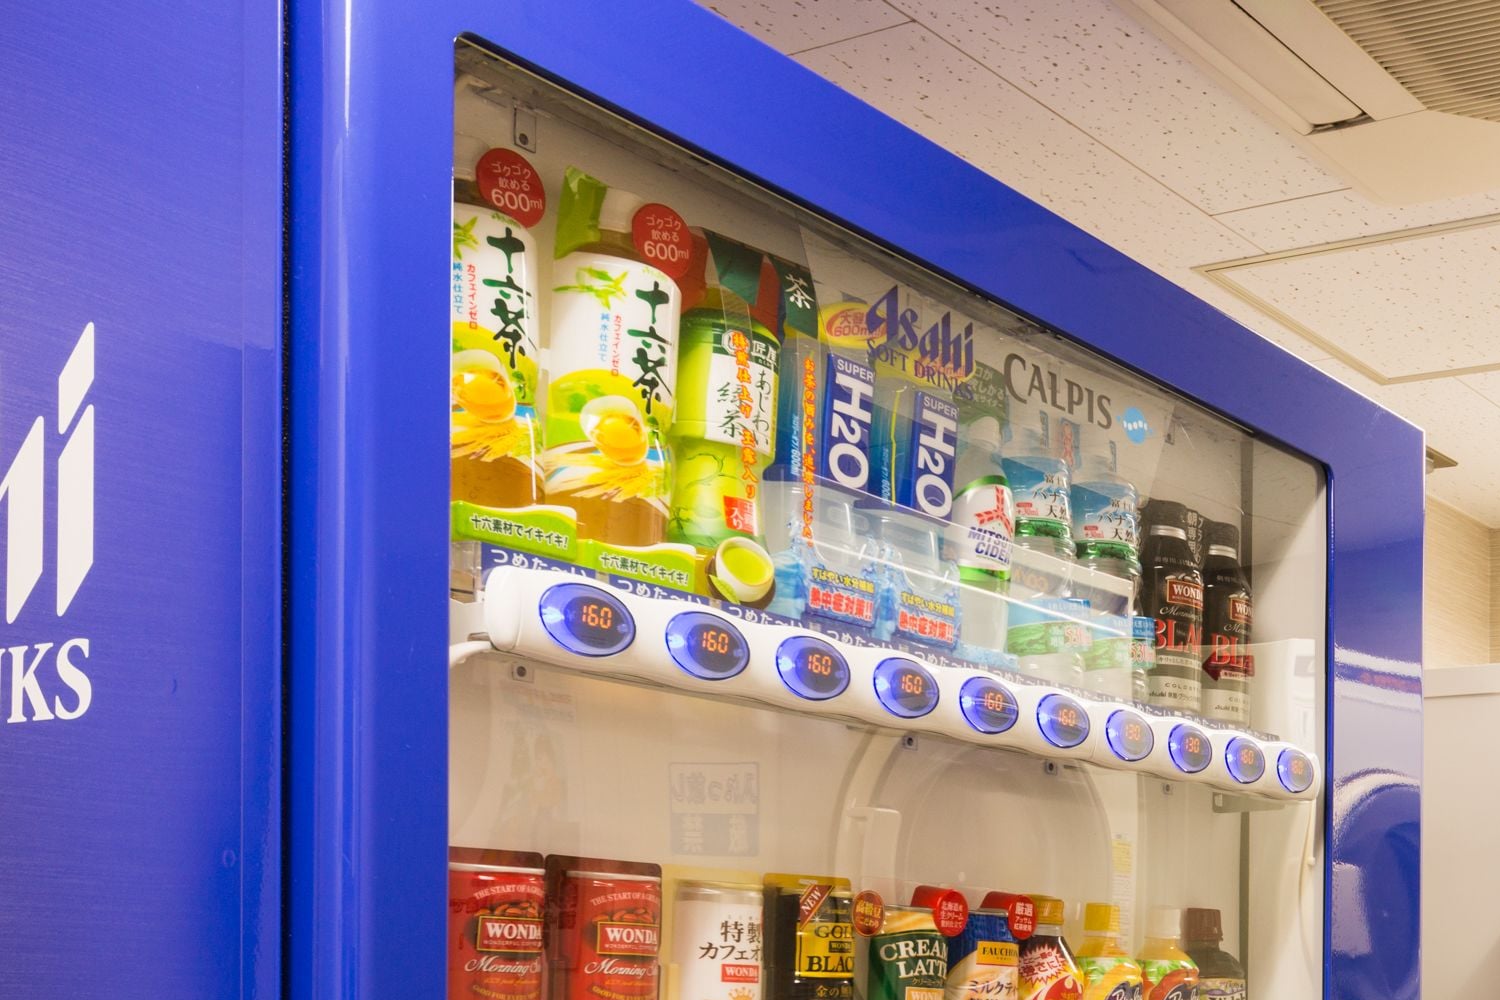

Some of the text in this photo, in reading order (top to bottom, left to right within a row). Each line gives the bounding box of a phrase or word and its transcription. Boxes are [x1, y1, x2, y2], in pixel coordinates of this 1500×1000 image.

[491, 162, 531, 179] ゴクゴク
[498, 177, 531, 192] 飲める
[491, 188, 543, 212] 600ml
[646, 215, 682, 231] ゴクゴク
[651, 229, 680, 243] 飲める
[644, 240, 690, 261] 600ml
[467, 264, 478, 330] カフェインゼロ
[482, 227, 538, 369] 十六茶
[785, 273, 815, 310] 茶
[866, 285, 974, 377] Asahi
[612, 315, 622, 377] カフェインゼロ
[627, 280, 672, 414] 十六茶
[837, 358, 875, 383] SUPER
[867, 337, 910, 368] SOFT
[914, 362, 975, 401] DRINKS
[1004, 353, 1112, 430] CALPIS
[923, 396, 958, 418] SUPER
[828, 373, 875, 490] H2O
[915, 405, 957, 519] H2O
[582, 604, 612, 629] 160
[703, 631, 728, 654] 160
[808, 654, 832, 676] 160
[901, 674, 923, 695] 160
[984, 691, 1004, 712] 160
[1059, 707, 1077, 727] 160
[1184, 736, 1200, 753] 130
[491, 885, 516, 898] START
[801, 888, 823, 915] NEW
[1015, 902, 1033, 916] 厳選
[721, 921, 762, 944] 特製
[465, 955, 530, 977] Morning
[585, 958, 647, 978] Morning
